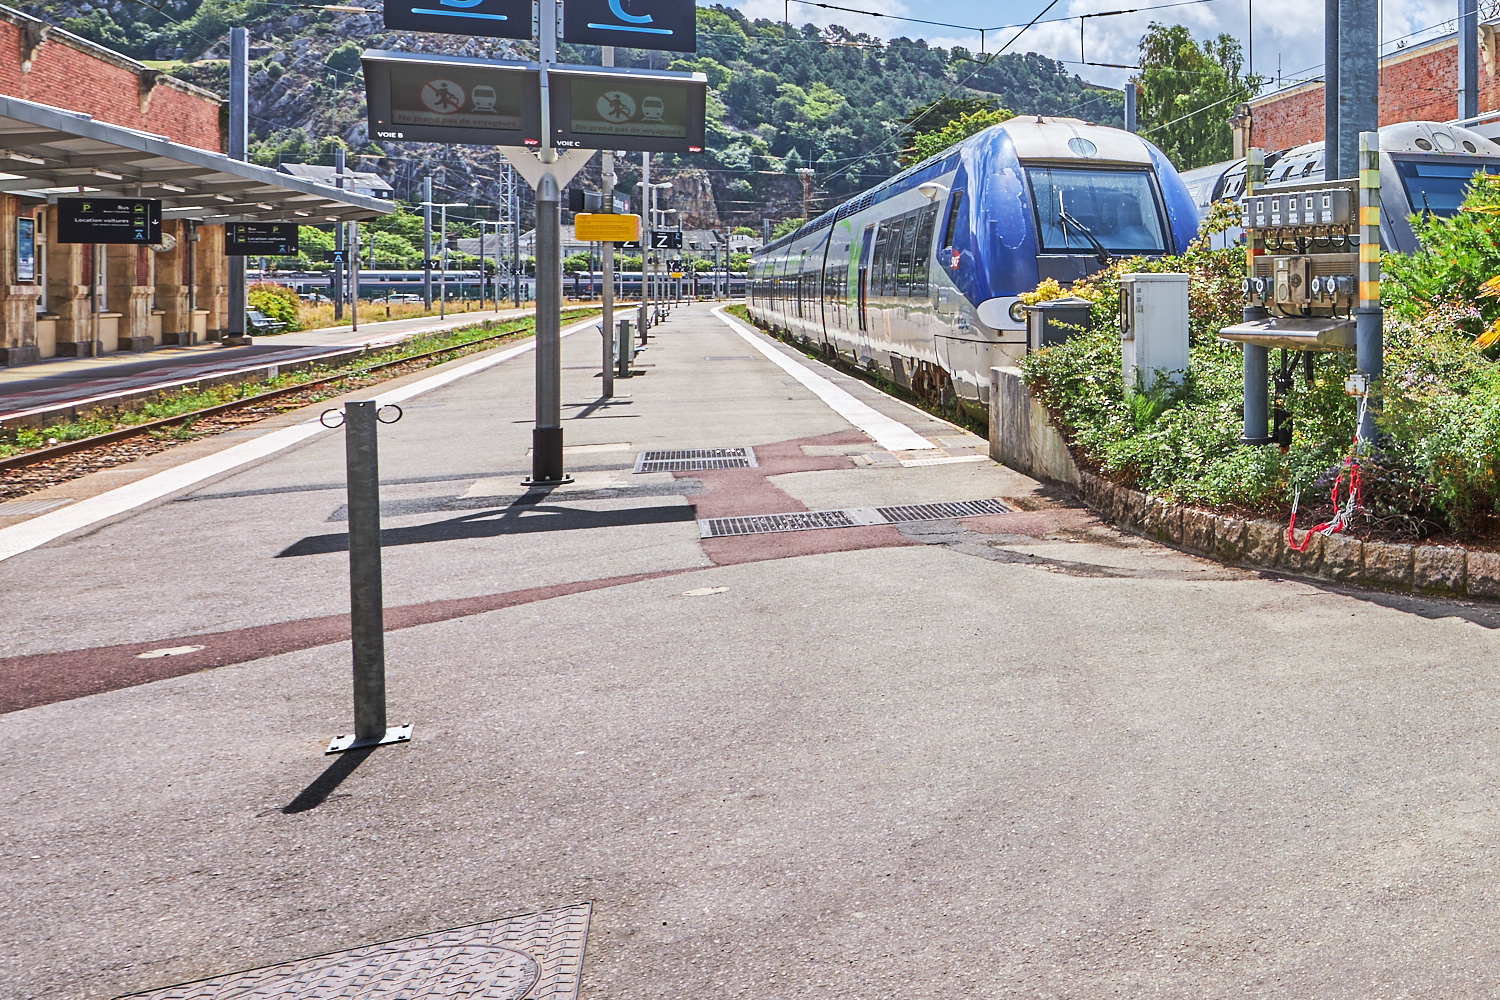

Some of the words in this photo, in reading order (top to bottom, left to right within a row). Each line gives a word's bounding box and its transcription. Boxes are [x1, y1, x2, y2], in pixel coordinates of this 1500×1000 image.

[414, 115, 440, 123] prend
[473, 119, 517, 127] voyageurs
[575, 123, 587, 131] Ne
[589, 124, 613, 132] prend
[642, 128, 682, 136] voyageurs
[83, 204, 91, 212] P
[656, 235, 668, 248] Z
[334, 253, 343, 262] A
